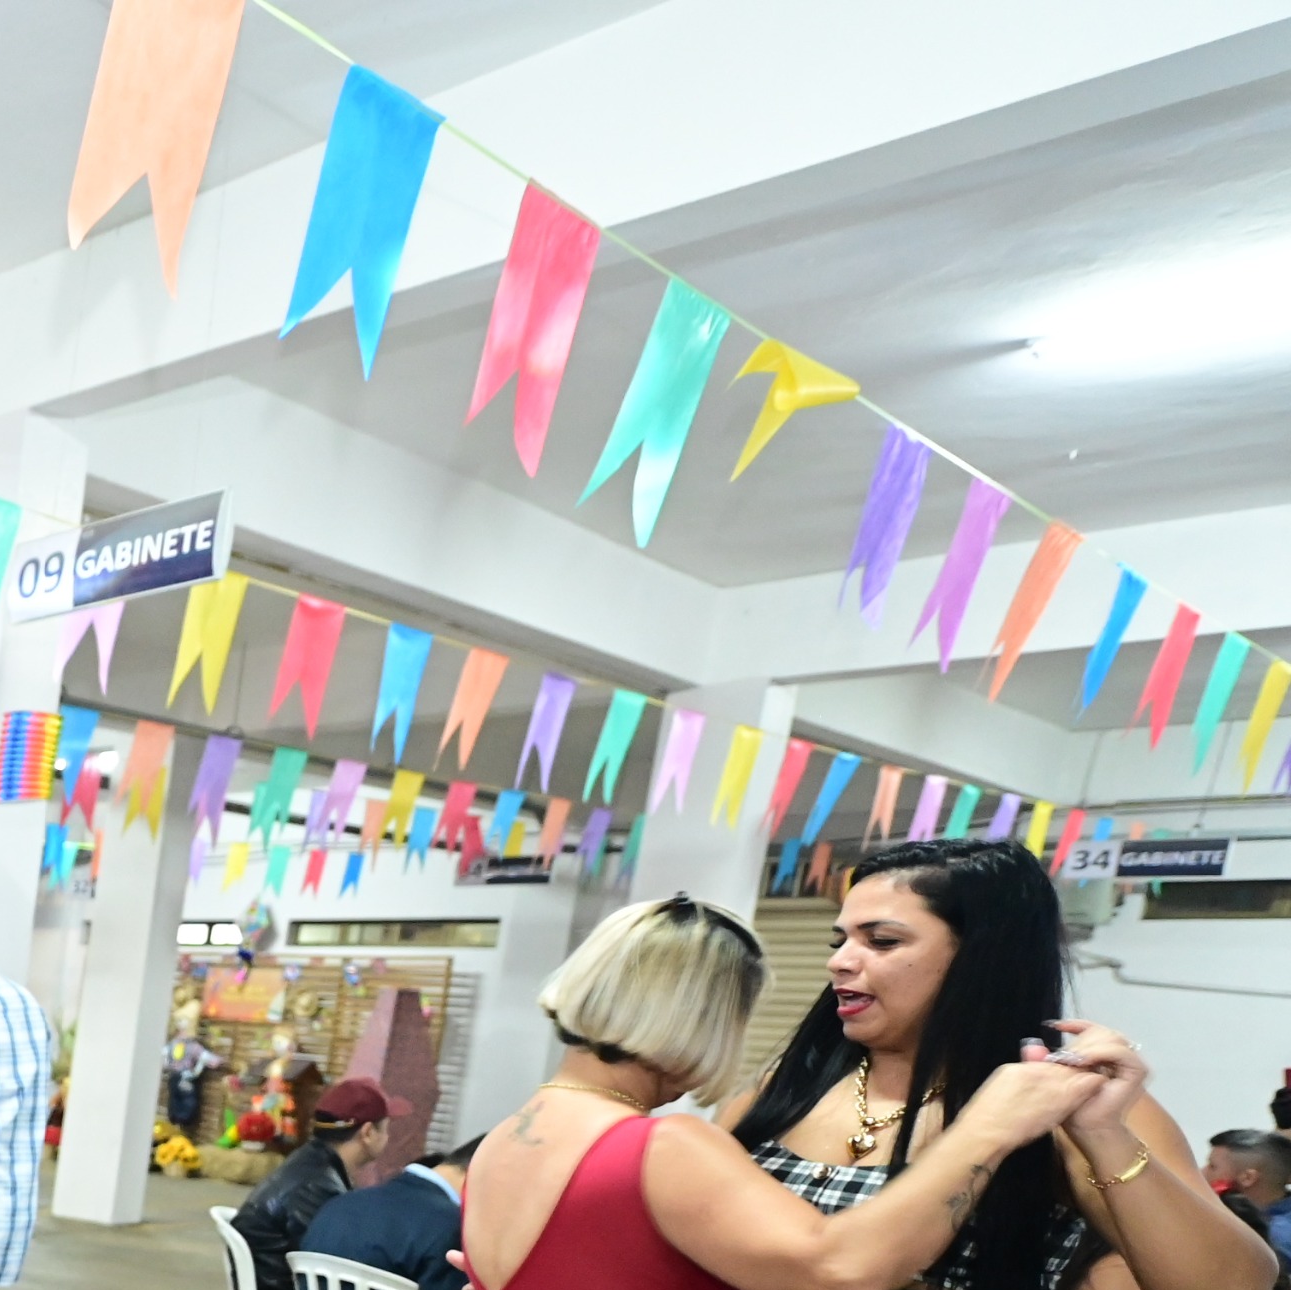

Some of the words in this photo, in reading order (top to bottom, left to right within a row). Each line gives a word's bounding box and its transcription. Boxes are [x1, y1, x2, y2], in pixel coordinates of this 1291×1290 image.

[19, 551, 65, 598] 09
[75, 519, 214, 579] GABINETE
[1071, 850, 1110, 870] 34
